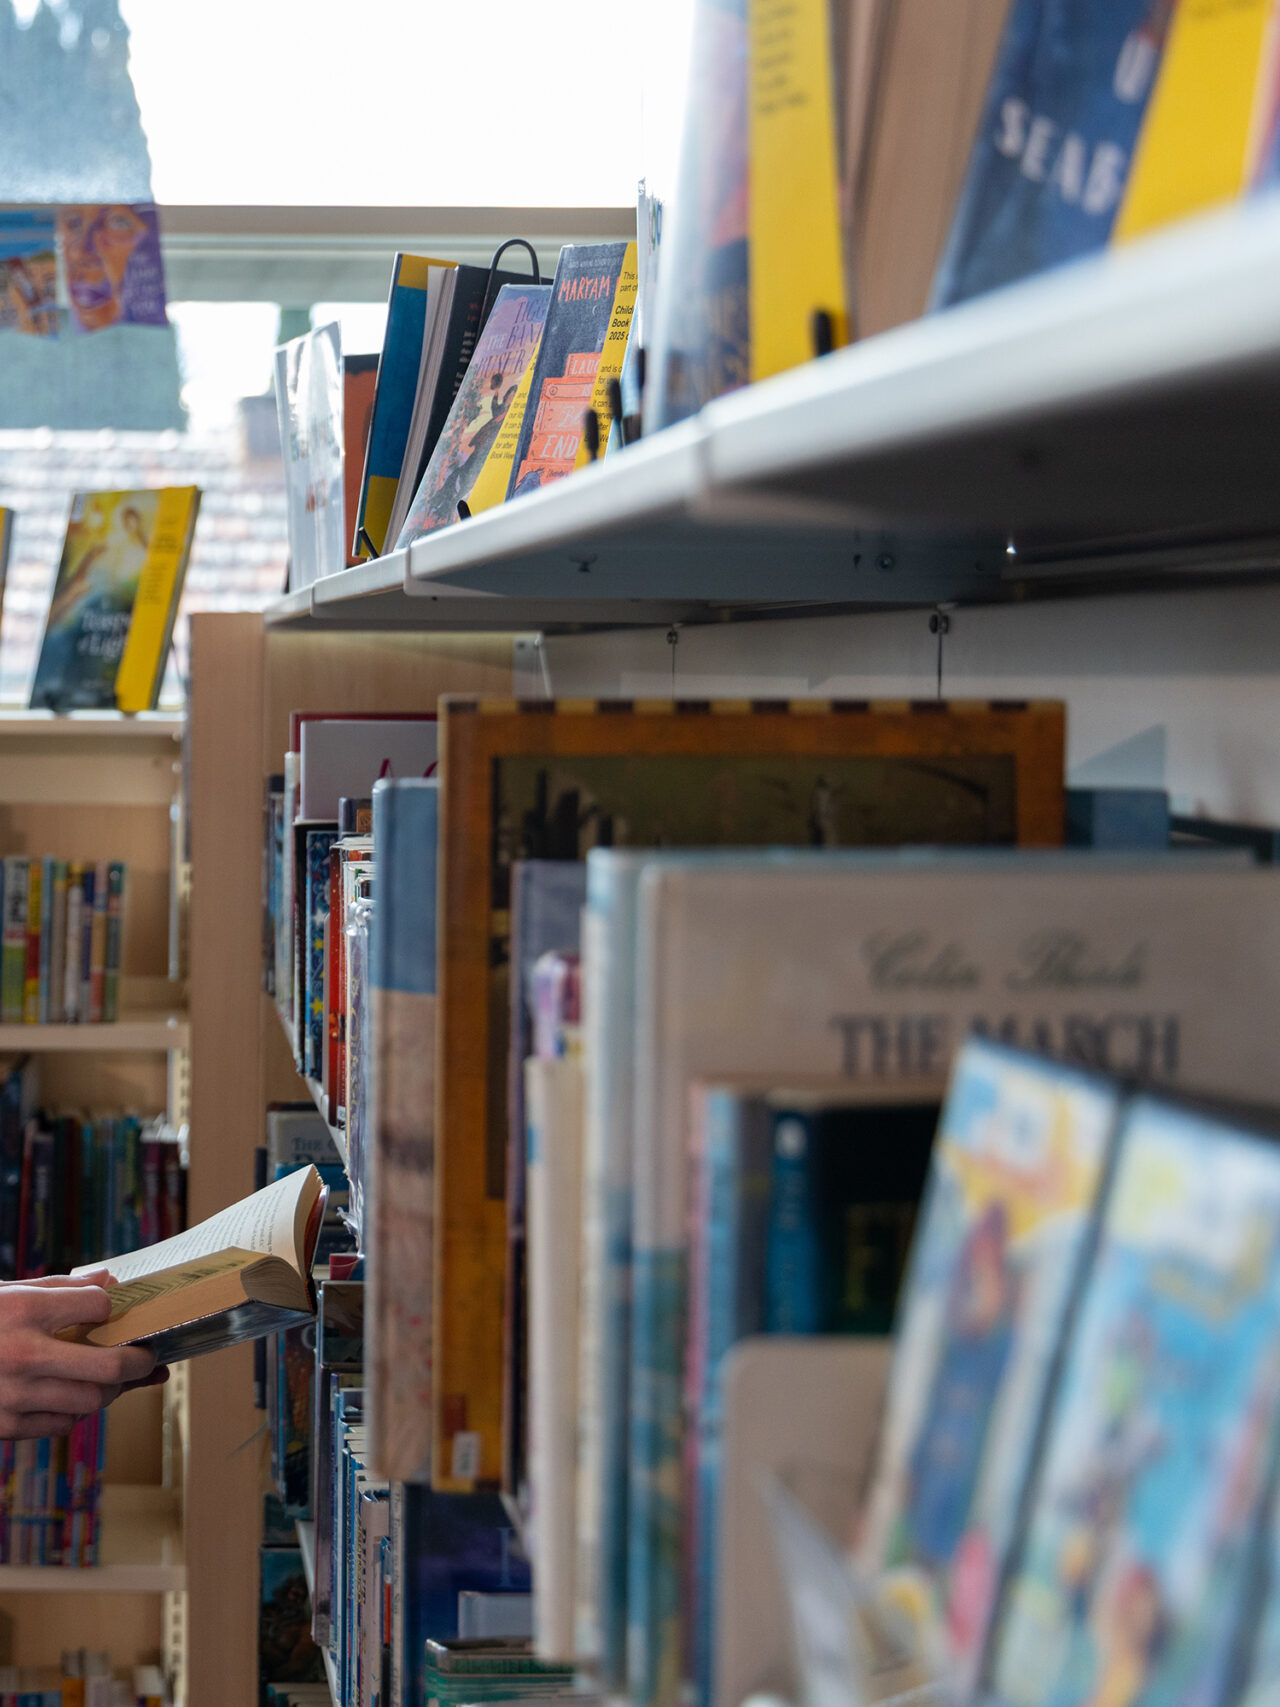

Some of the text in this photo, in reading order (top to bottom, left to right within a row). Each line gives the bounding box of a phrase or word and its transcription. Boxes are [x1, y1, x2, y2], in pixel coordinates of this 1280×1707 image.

[623, 272, 635, 280] This
[558, 274, 610, 302] MARYAM
[620, 285, 631, 293] part
[615, 306, 634, 315] Child
[612, 318, 629, 327] Book
[609, 331, 625, 340] 2025
[601, 364, 612, 372] and
[540, 434, 579, 459] END
[826, 1011, 950, 1080] THE
